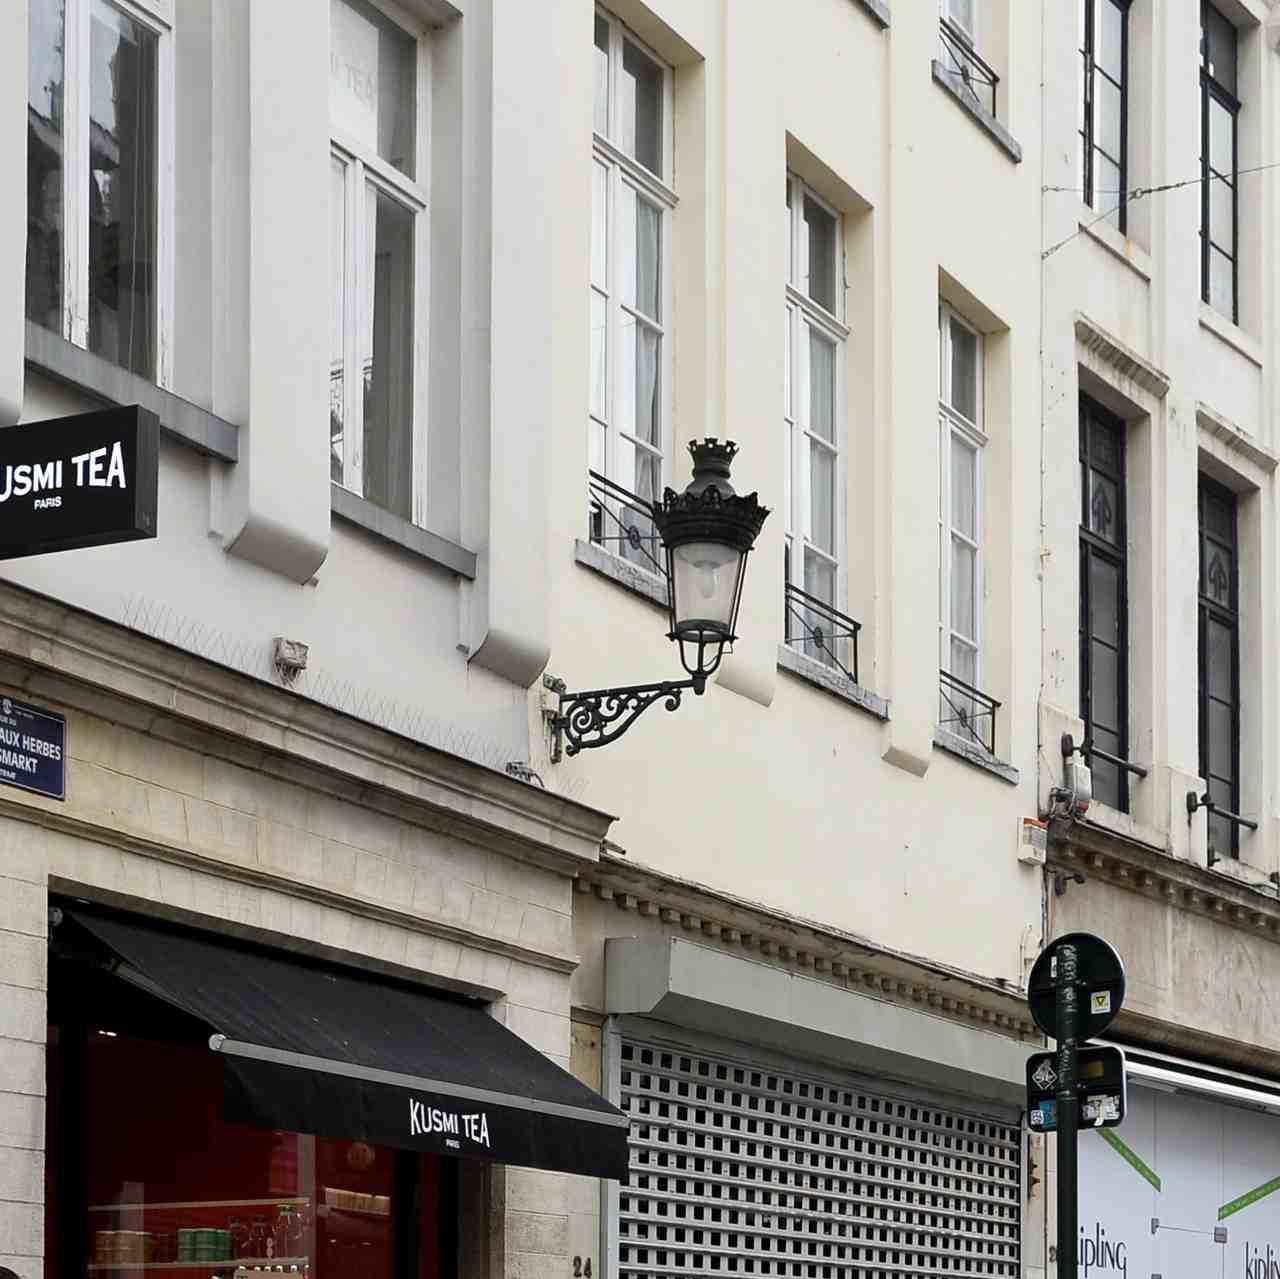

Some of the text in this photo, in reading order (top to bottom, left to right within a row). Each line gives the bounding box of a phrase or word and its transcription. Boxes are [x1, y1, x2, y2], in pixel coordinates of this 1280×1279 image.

[71, 441, 126, 488] TEA
[34, 496, 62, 510] PARIS
[22, 735, 62, 761] HERBES
[409, 1098, 491, 1148] KUSMI TEA
[573, 1255, 592, 1279] 24
